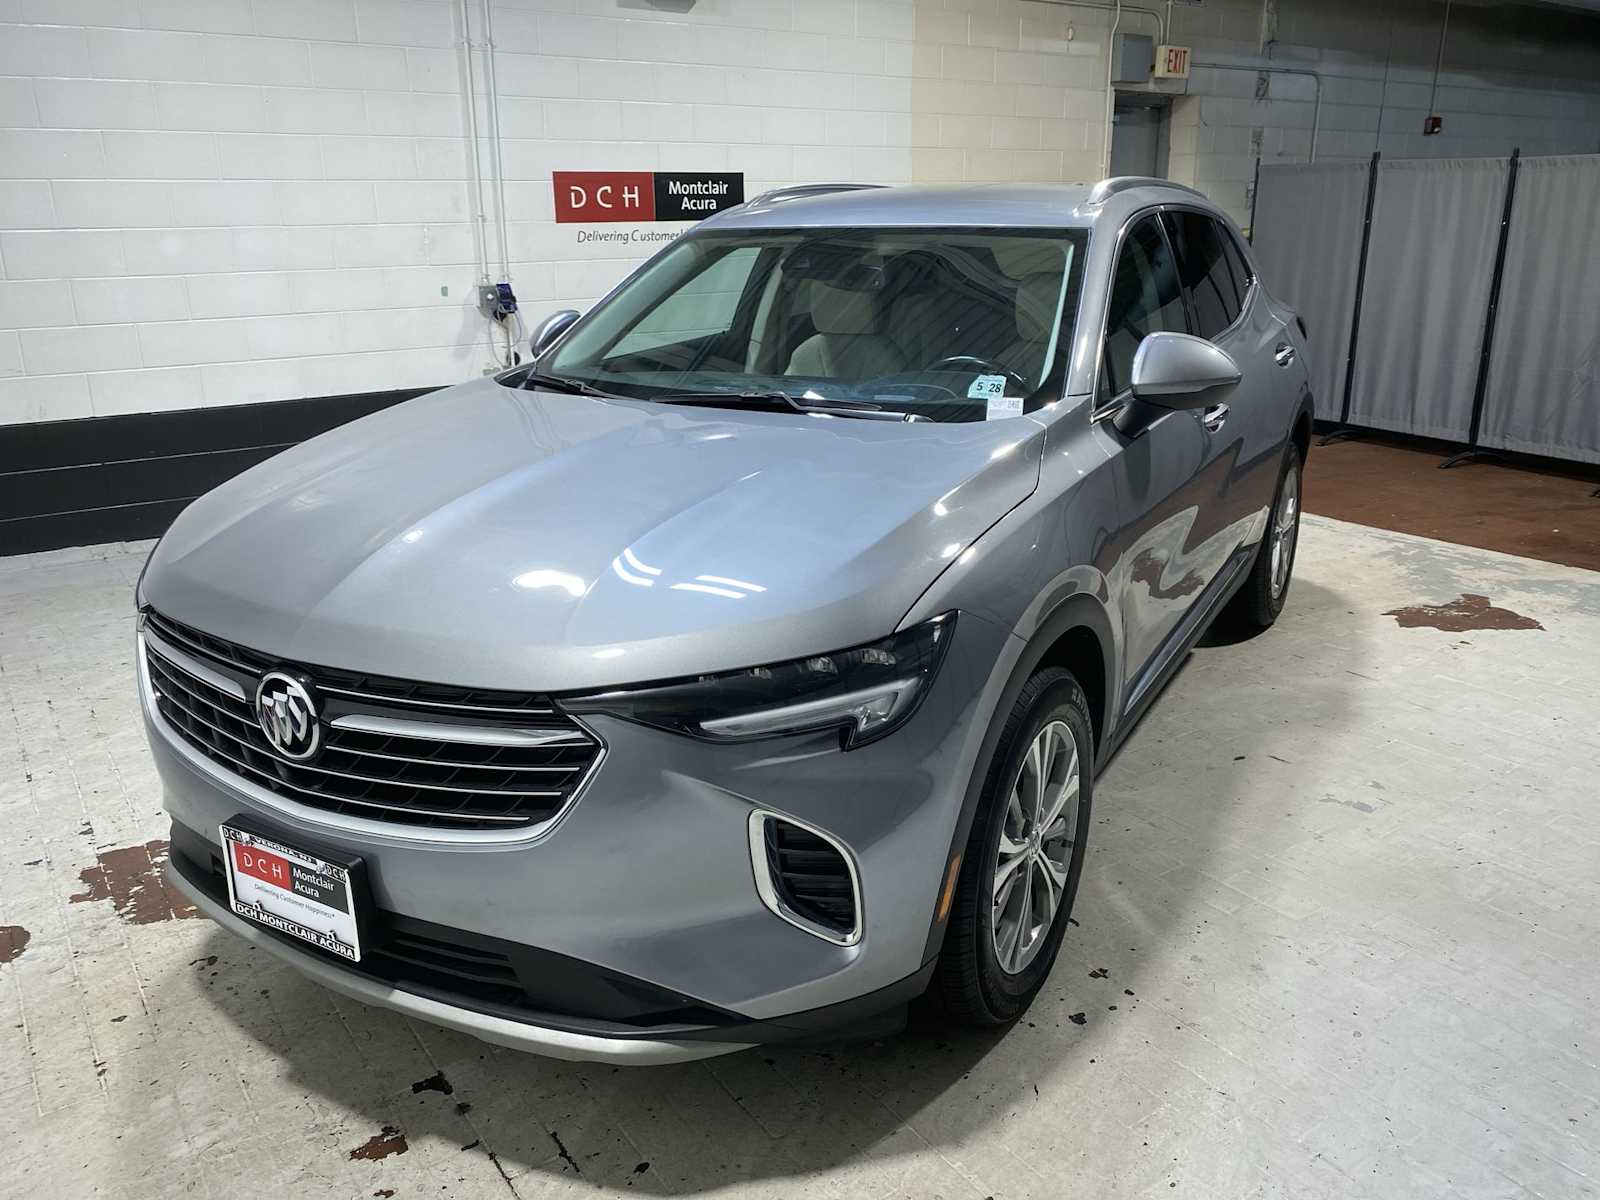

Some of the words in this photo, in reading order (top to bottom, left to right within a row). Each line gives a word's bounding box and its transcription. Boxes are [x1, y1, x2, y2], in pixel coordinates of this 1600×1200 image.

[1167, 49, 1187, 73] EXIT
[668, 181, 728, 195] Montclair
[681, 197, 716, 210] Acura
[577, 230, 629, 244] Delivering
[976, 381, 984, 391] 5
[988, 383, 1002, 393] 28
[243, 852, 283, 879] DCH
[292, 867, 334, 891] Montclair
[294, 881, 320, 898] Acura
[236, 904, 258, 919] DCH
[259, 914, 318, 942] MONTCLAIR
[320, 937, 354, 959] ACURA
